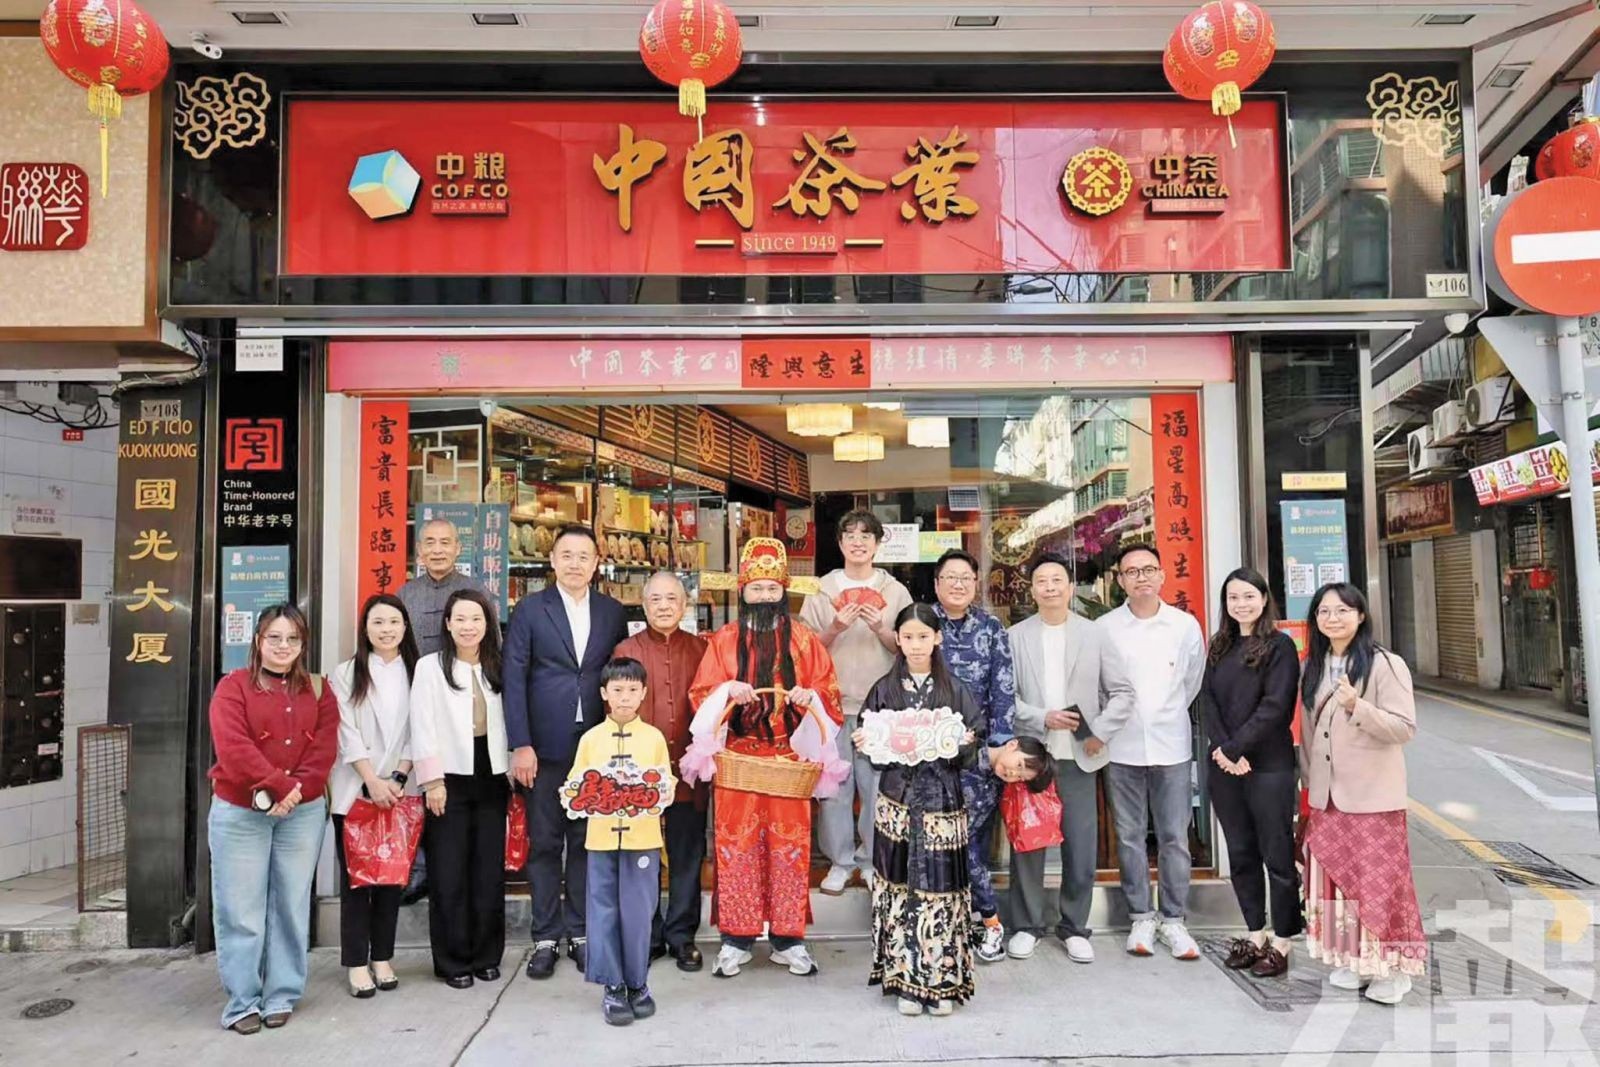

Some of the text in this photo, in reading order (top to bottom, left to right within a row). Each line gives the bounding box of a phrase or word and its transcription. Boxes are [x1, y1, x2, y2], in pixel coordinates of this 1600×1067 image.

[431, 183, 508, 198] COFCO
[1142, 183, 1230, 198] CHINATEA
[743, 233, 836, 252] since 1949
[1444, 278, 1466, 293] 106
[157, 404, 179, 417] 108
[223, 480, 252, 489] China
[223, 491, 295, 500] Time-Honored
[223, 502, 253, 512] Brand
[223, 513, 294, 528] 中华老字号
